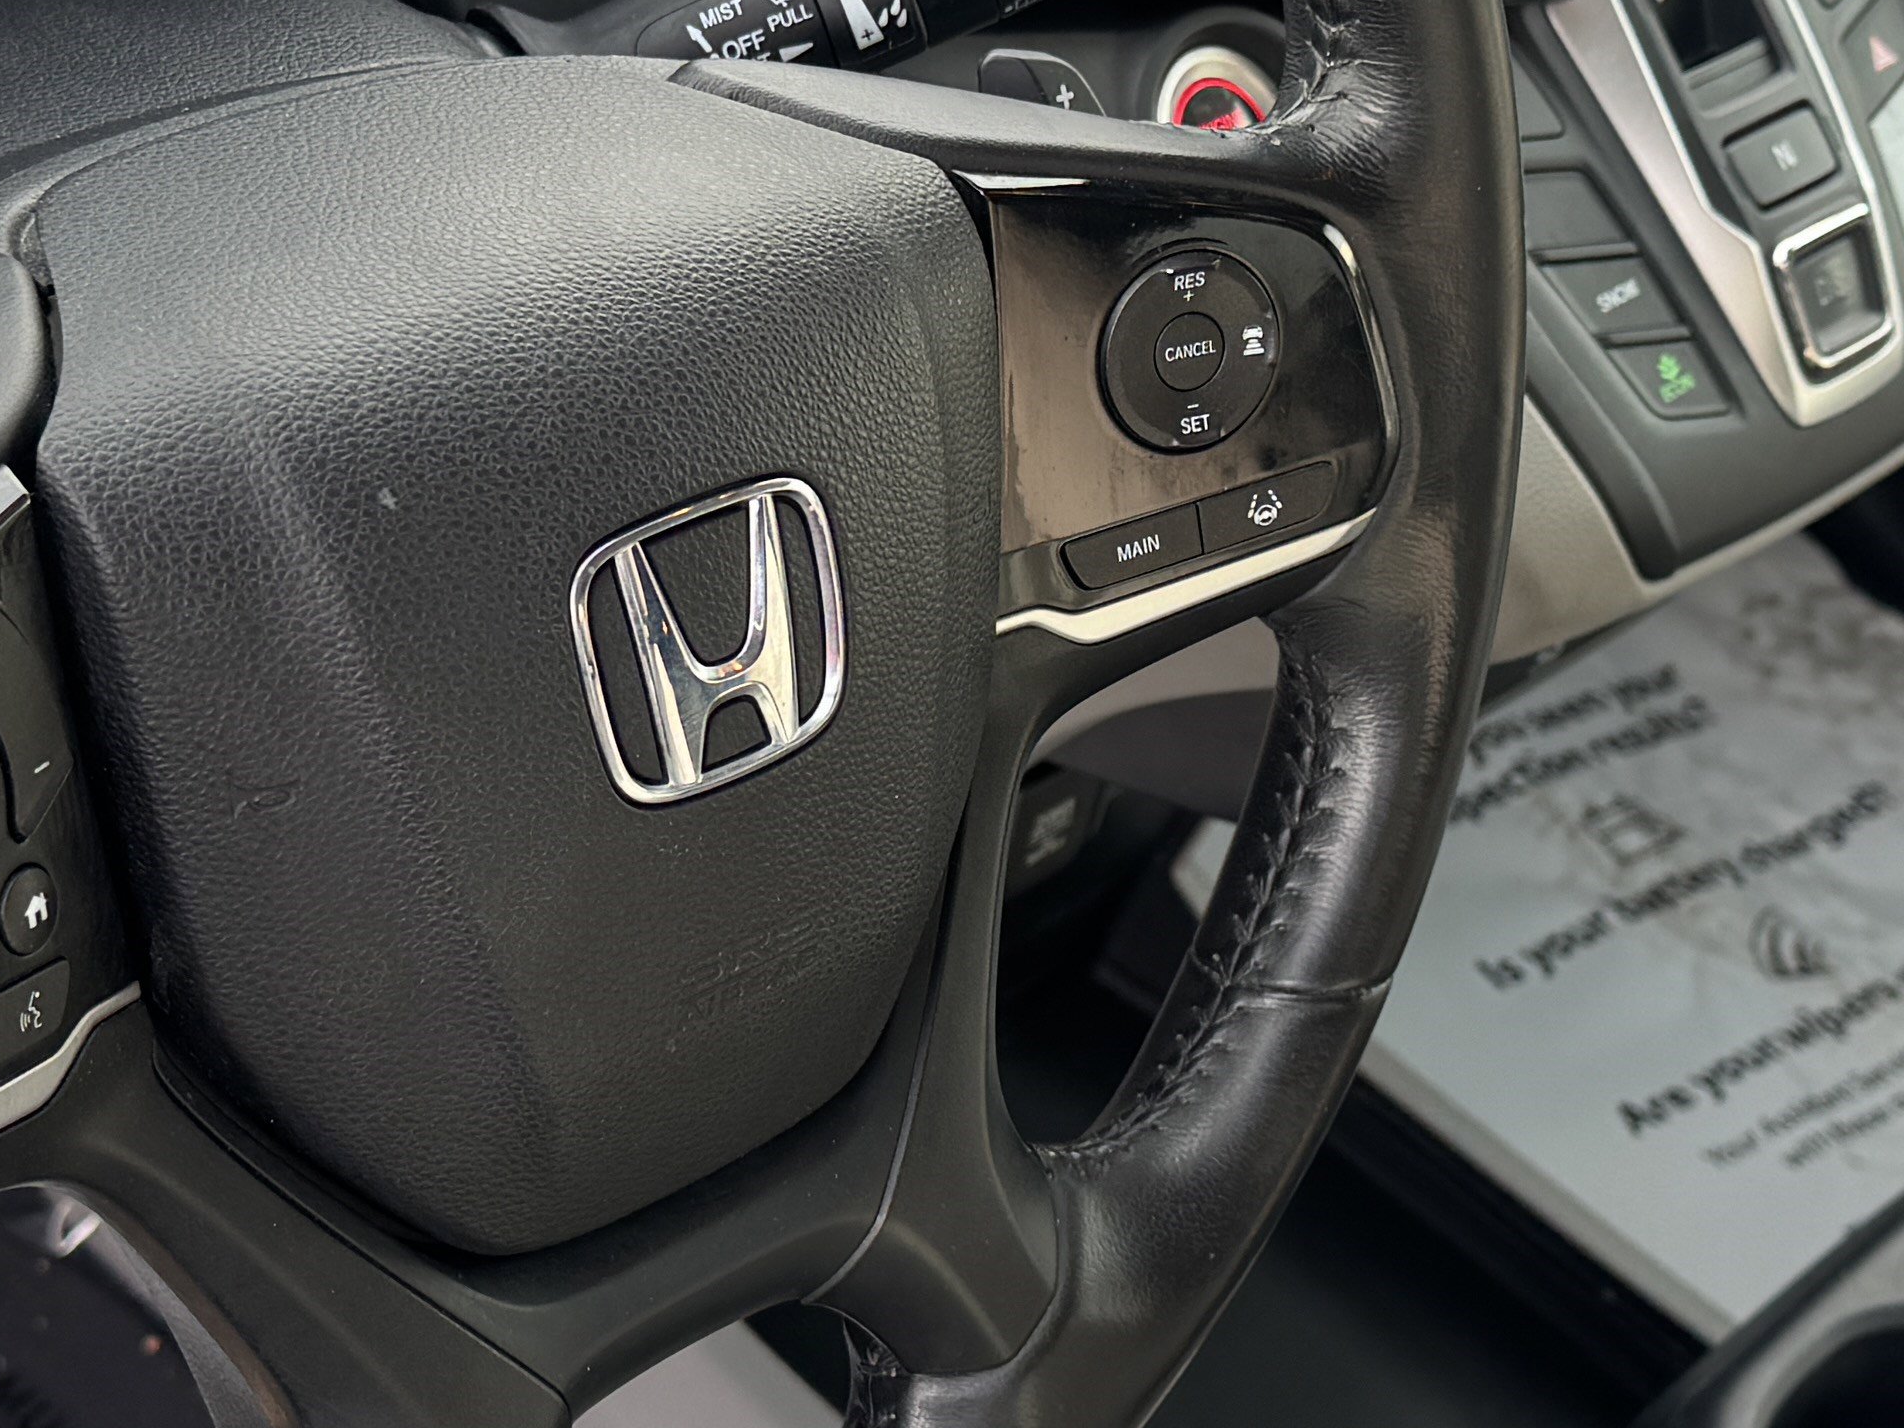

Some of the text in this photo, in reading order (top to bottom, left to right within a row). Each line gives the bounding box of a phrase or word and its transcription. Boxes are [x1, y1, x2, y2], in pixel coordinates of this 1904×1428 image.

[766, 4, 814, 32] PULL
[722, 28, 766, 60] OFF
[1770, 141, 1798, 172] N
[1174, 272, 1206, 291] RES
[1164, 340, 1217, 362] CANCEL
[1180, 414, 1210, 435] SET
[1116, 535, 1161, 562] MAIN
[1616, 1080, 1694, 1140] Are
